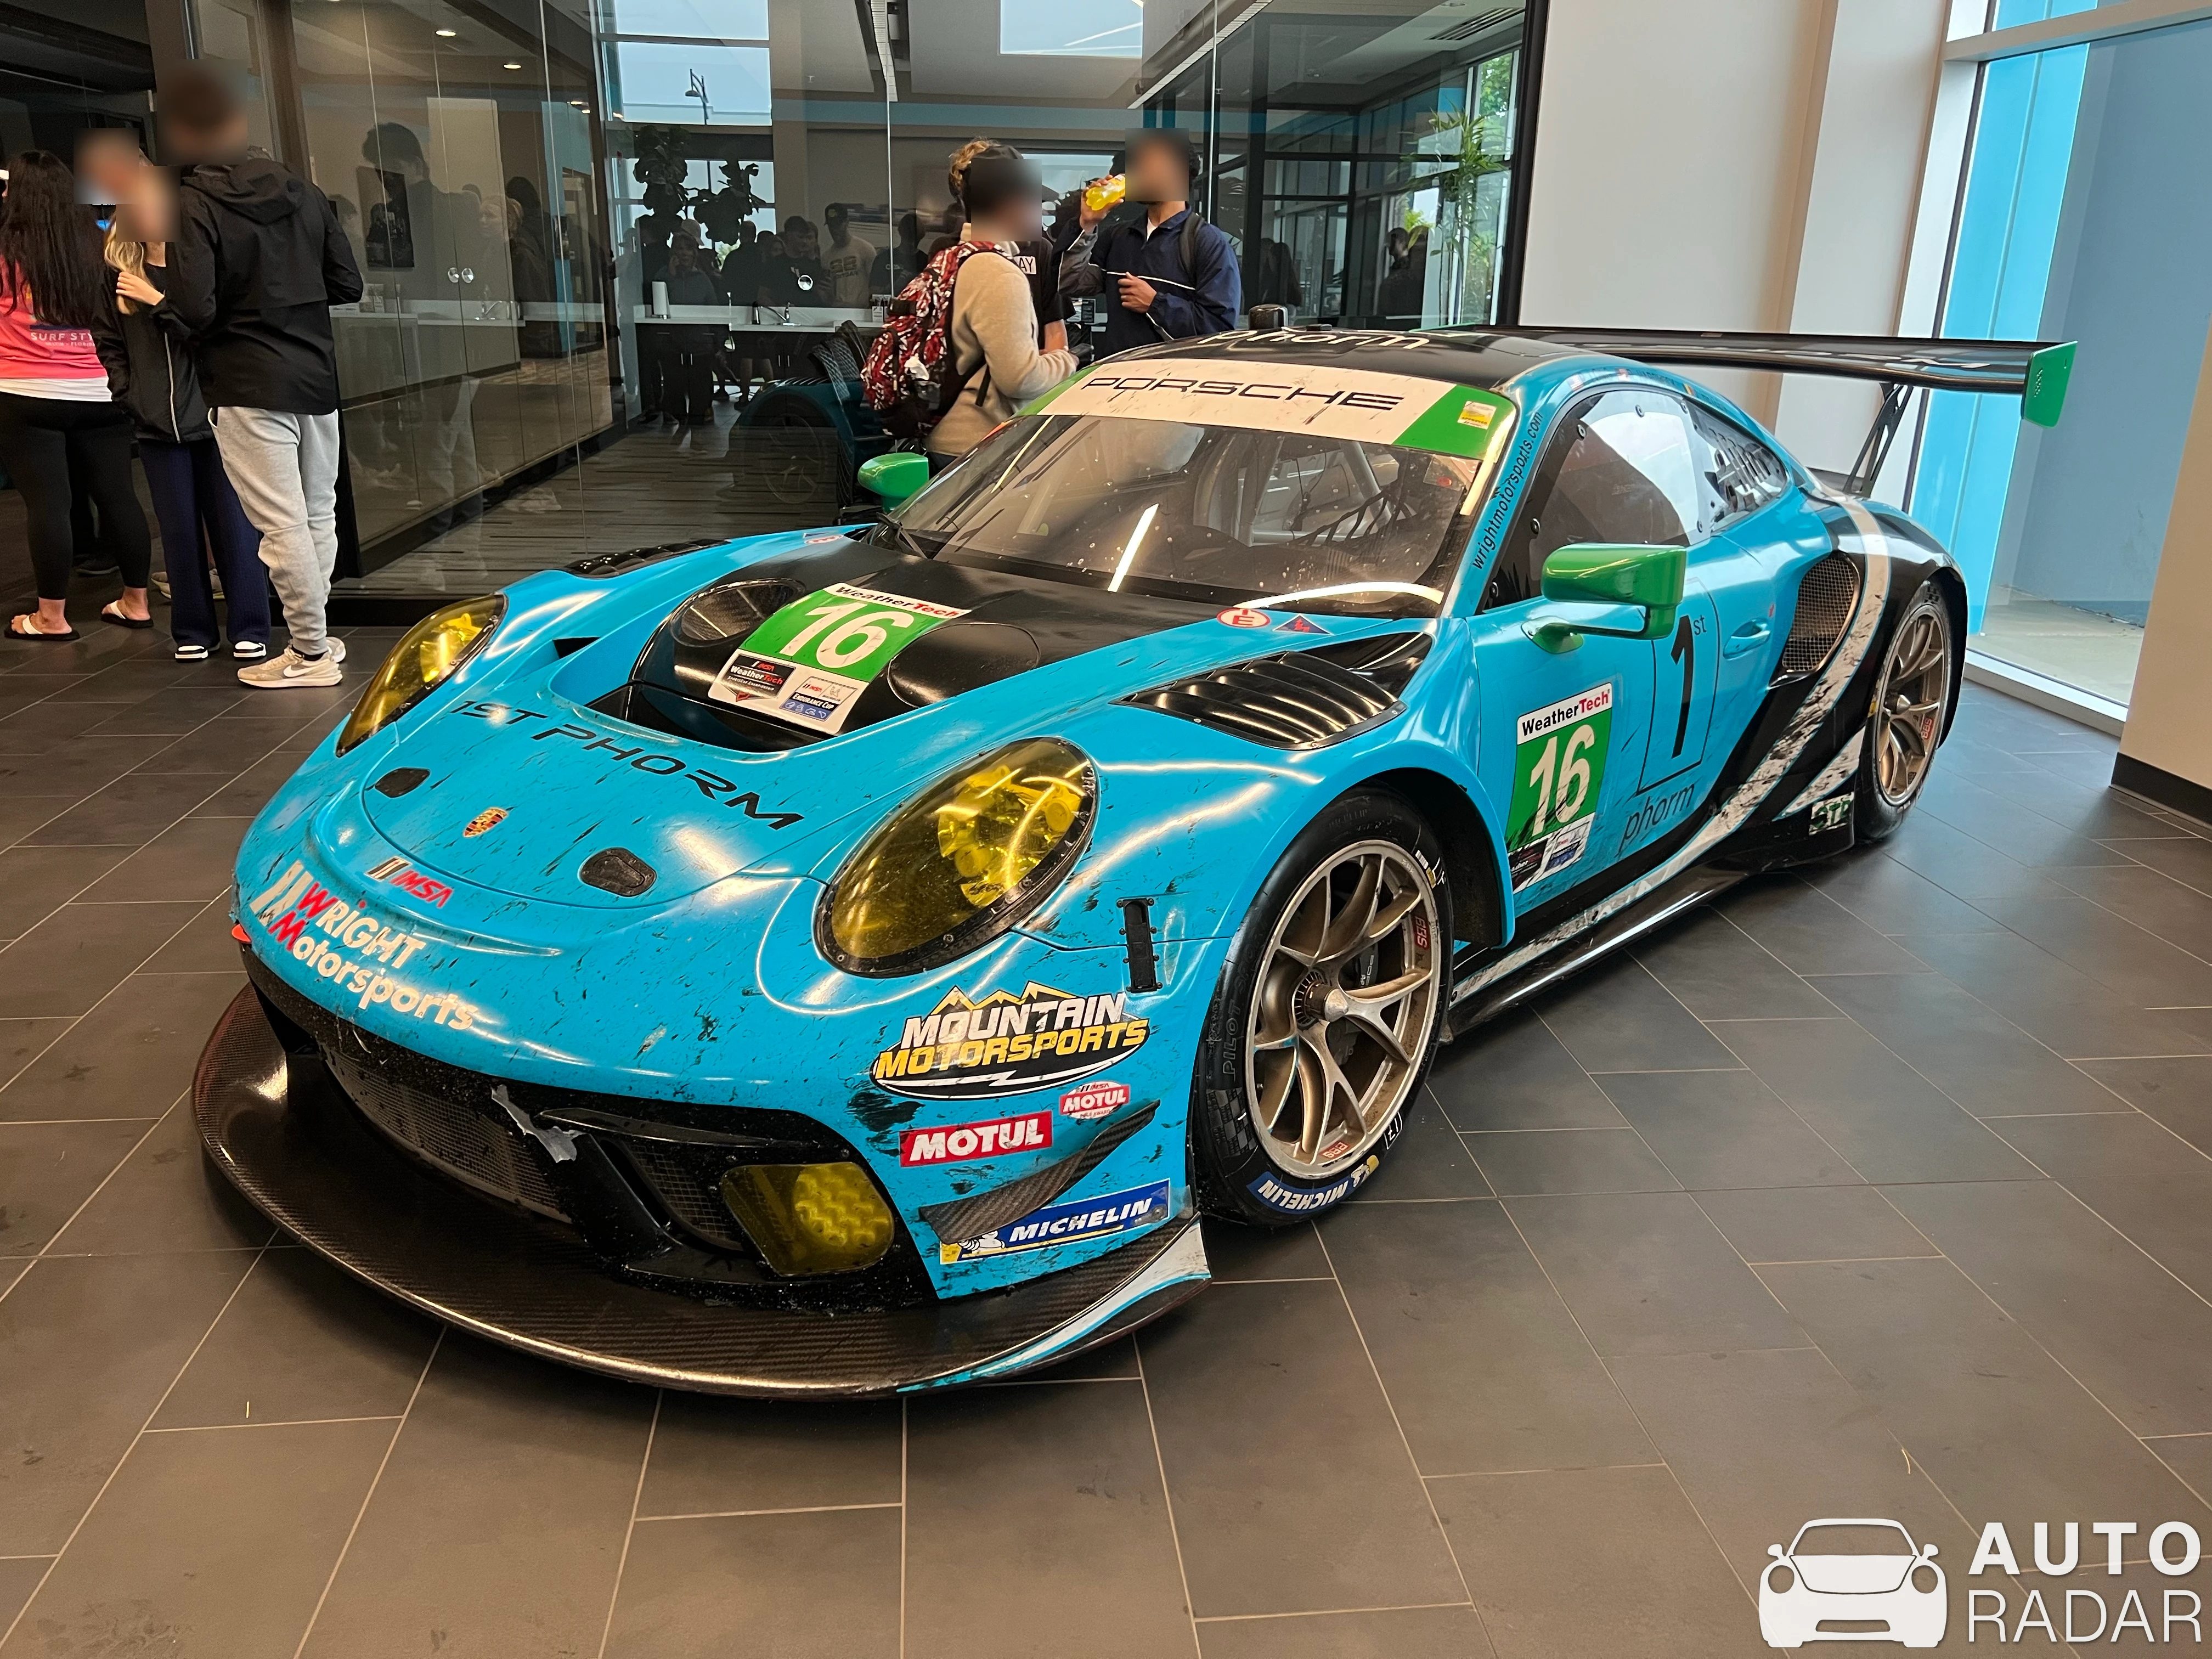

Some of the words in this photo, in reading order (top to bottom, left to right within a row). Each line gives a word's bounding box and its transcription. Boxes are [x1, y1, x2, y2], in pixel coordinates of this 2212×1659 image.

[30, 332, 65, 341] SURF
[1080, 376, 1404, 411] PORSCHE
[1471, 411, 1543, 572] wrightmotorsports.com
[836, 586, 960, 619] WeatherTech
[779, 603, 915, 668] 16
[730, 665, 783, 685] WeatherTech
[450, 700, 548, 725] 1ST
[1522, 692, 1609, 736] WeatherTech
[530, 724, 805, 831] PHORM
[1529, 724, 1595, 837] 16
[1618, 783, 1695, 855] phorm
[390, 870, 454, 909] IMSA
[296, 882, 427, 969] WRIGHT
[1414, 916, 1427, 949] BBS
[268, 911, 479, 1030] Motorsports
[901, 992, 1126, 1049] MOUNTAIN
[875, 1019, 1149, 1079] MOTORSPORTS
[1063, 1089, 1127, 1113] MOTUL
[909, 1119, 1045, 1162] MOTUL
[1323, 1142, 1348, 1159] BBS
[1257, 1179, 1350, 1210] MICHELIN
[1009, 1198, 1153, 1243] MICHELIN
